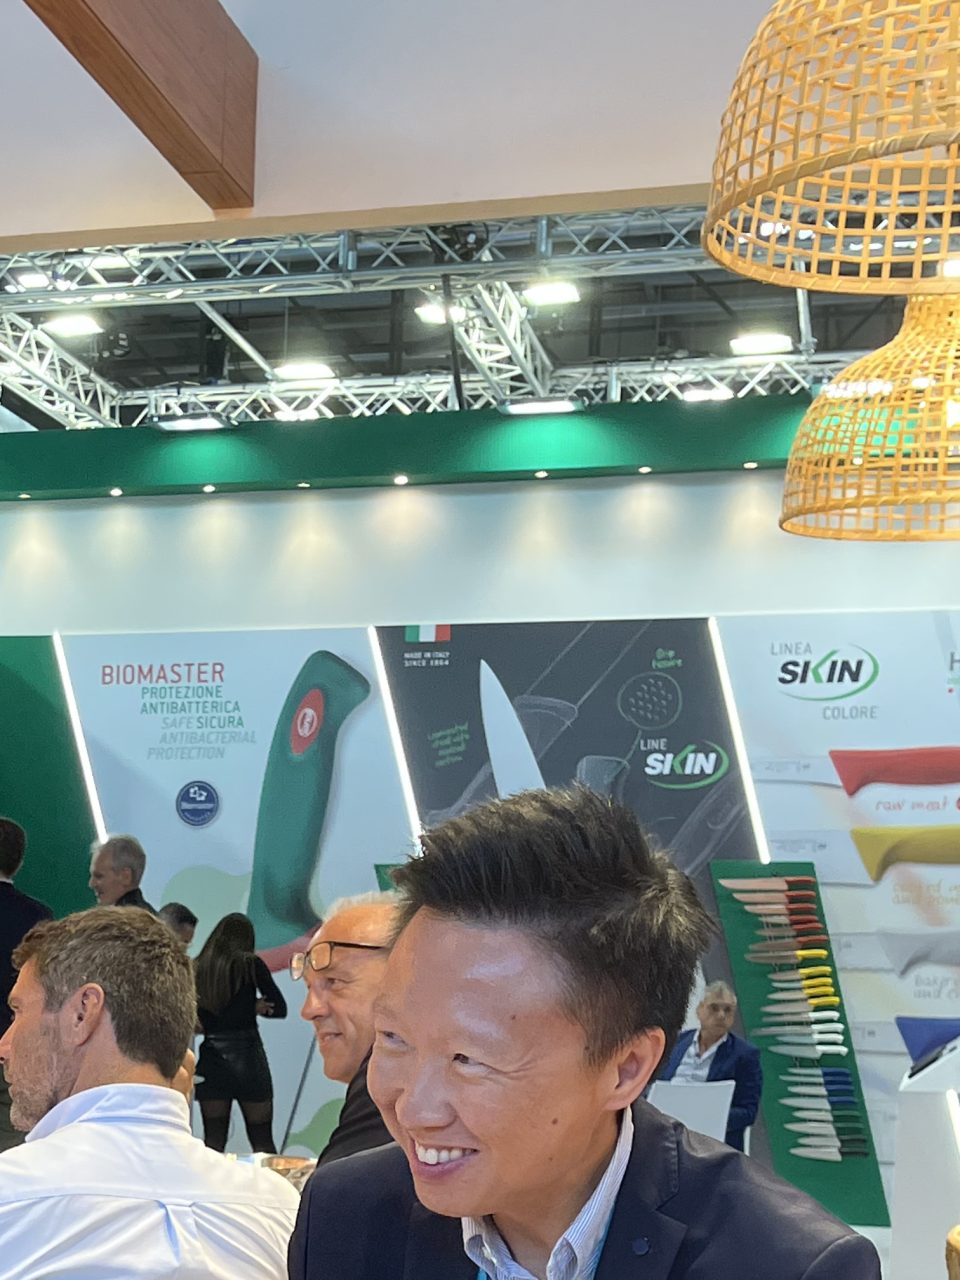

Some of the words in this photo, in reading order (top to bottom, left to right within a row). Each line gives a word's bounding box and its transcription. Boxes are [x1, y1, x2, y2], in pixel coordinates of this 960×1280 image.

[770, 641, 813, 656] LINEA
[101, 662, 225, 685] BIOMASTER
[778, 649, 864, 685] SKIN
[141, 685, 223, 700] PROTEZIONE
[140, 699, 241, 715] ANTIBATTERICA
[822, 705, 878, 720] COLORE
[161, 716, 194, 730] SAFE
[196, 715, 245, 729] SICURA
[159, 730, 258, 745] ANTIBACTERIAL
[640, 738, 668, 751] LINE
[146, 746, 226, 761] PROTECTION
[644, 743, 717, 775] SKIN
